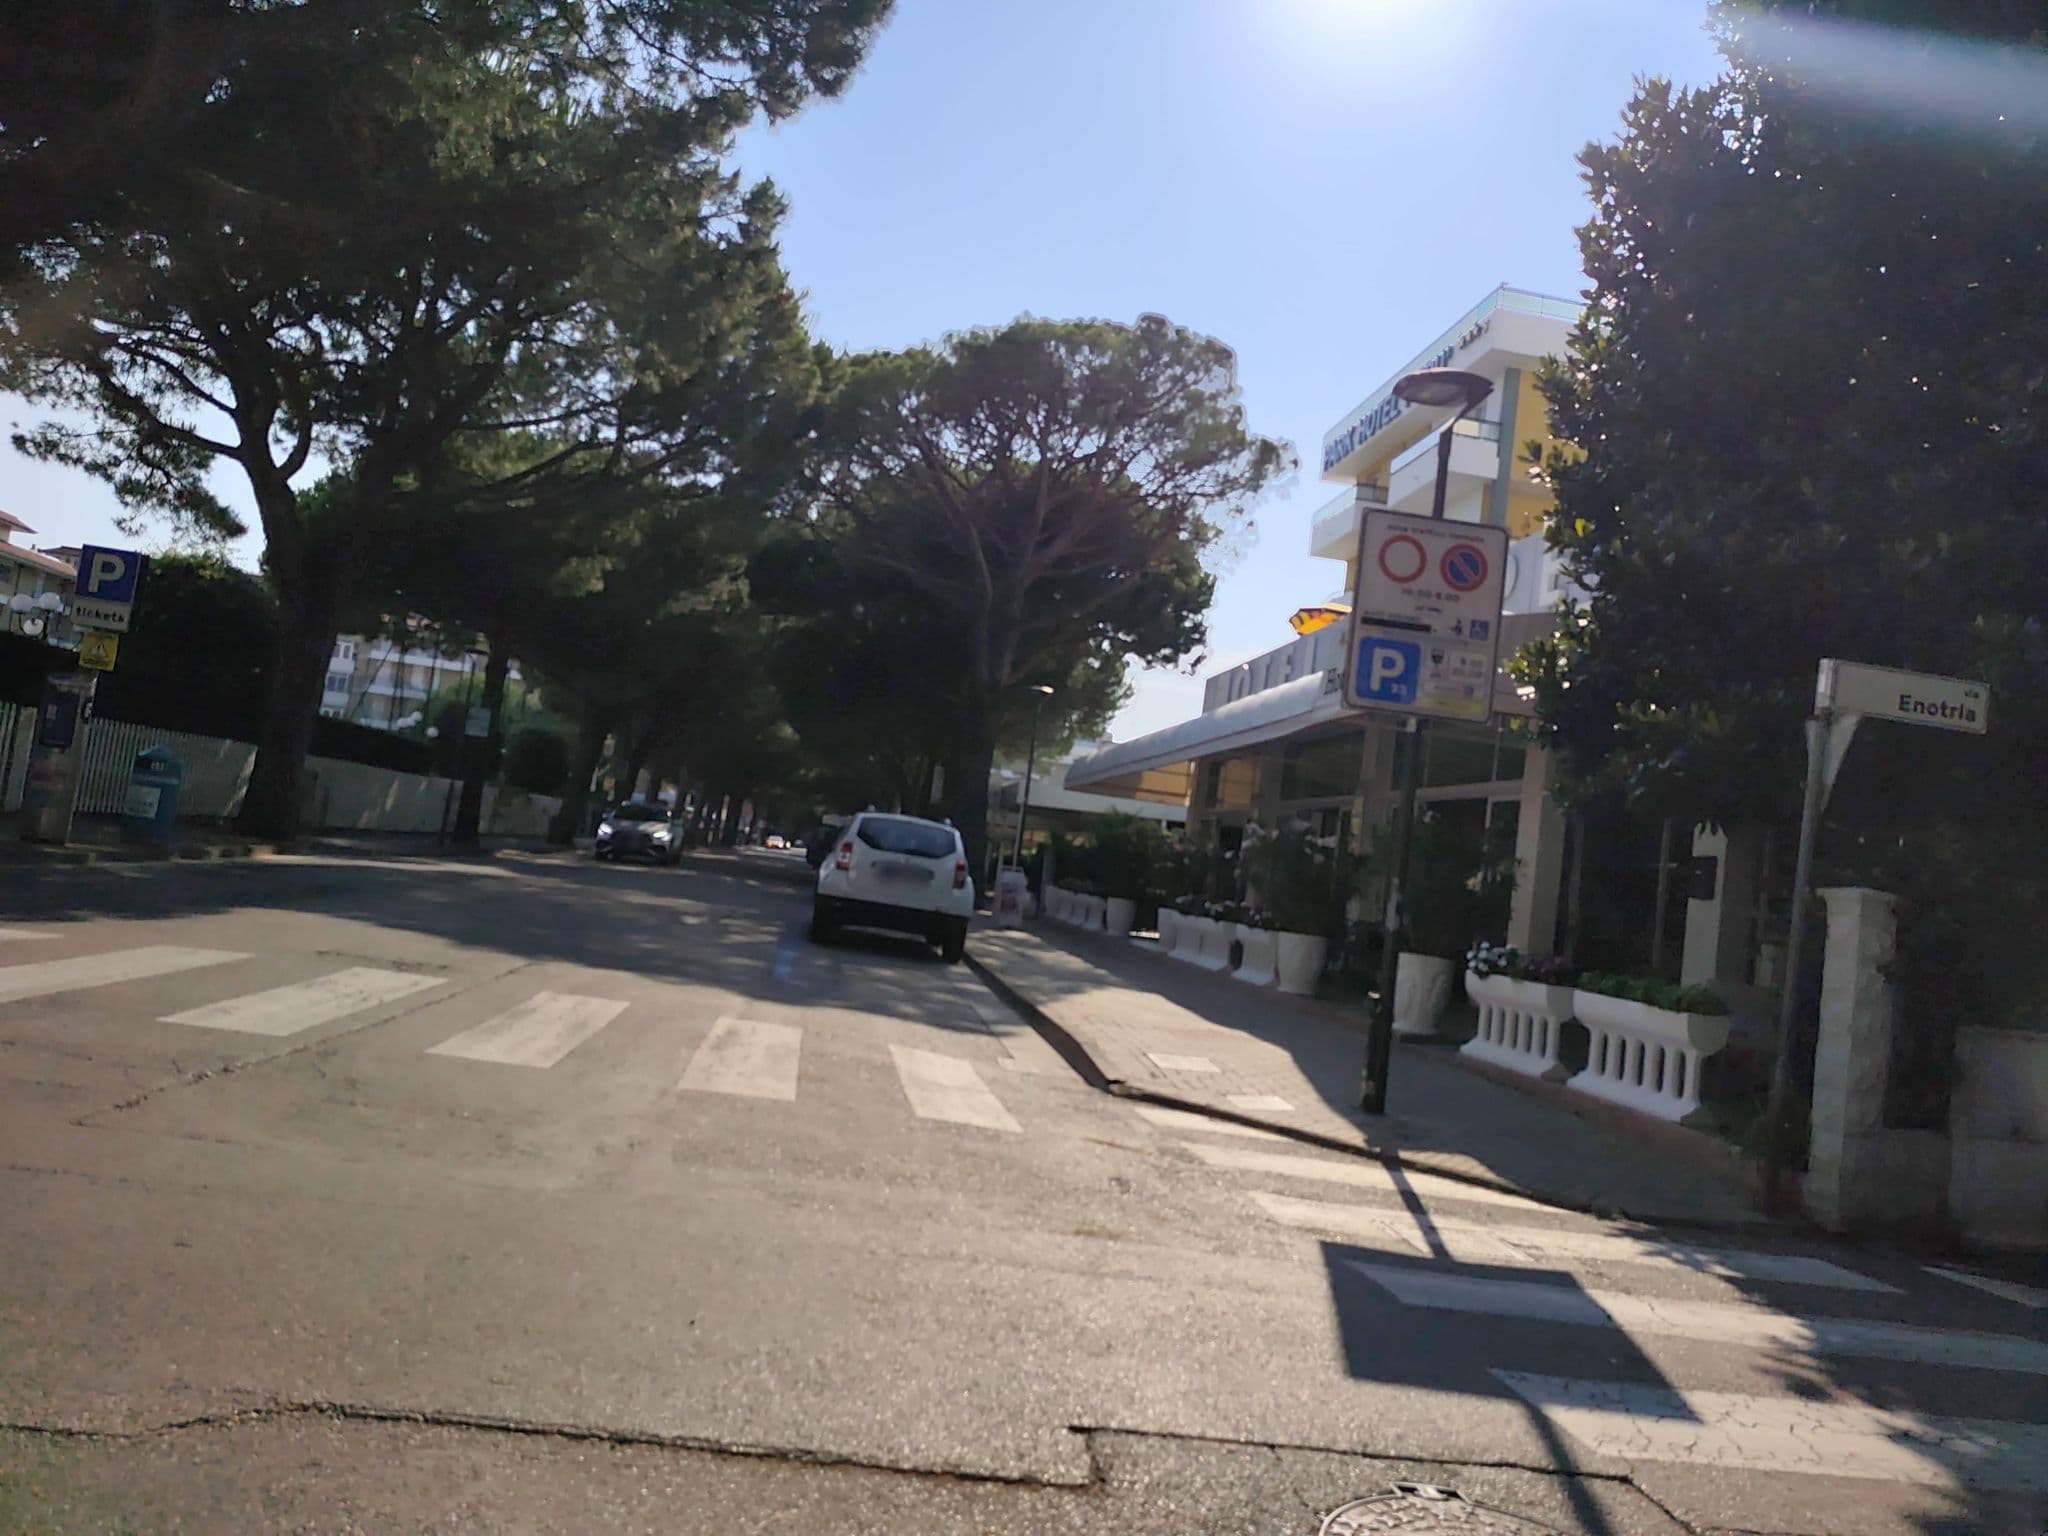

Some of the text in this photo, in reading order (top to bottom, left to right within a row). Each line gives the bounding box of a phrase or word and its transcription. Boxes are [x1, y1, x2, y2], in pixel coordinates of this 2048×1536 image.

[1359, 396, 1402, 445] HOTEL
[88, 551, 125, 593] P
[1369, 646, 1406, 691] P
[1898, 694, 1977, 723] Enotria
